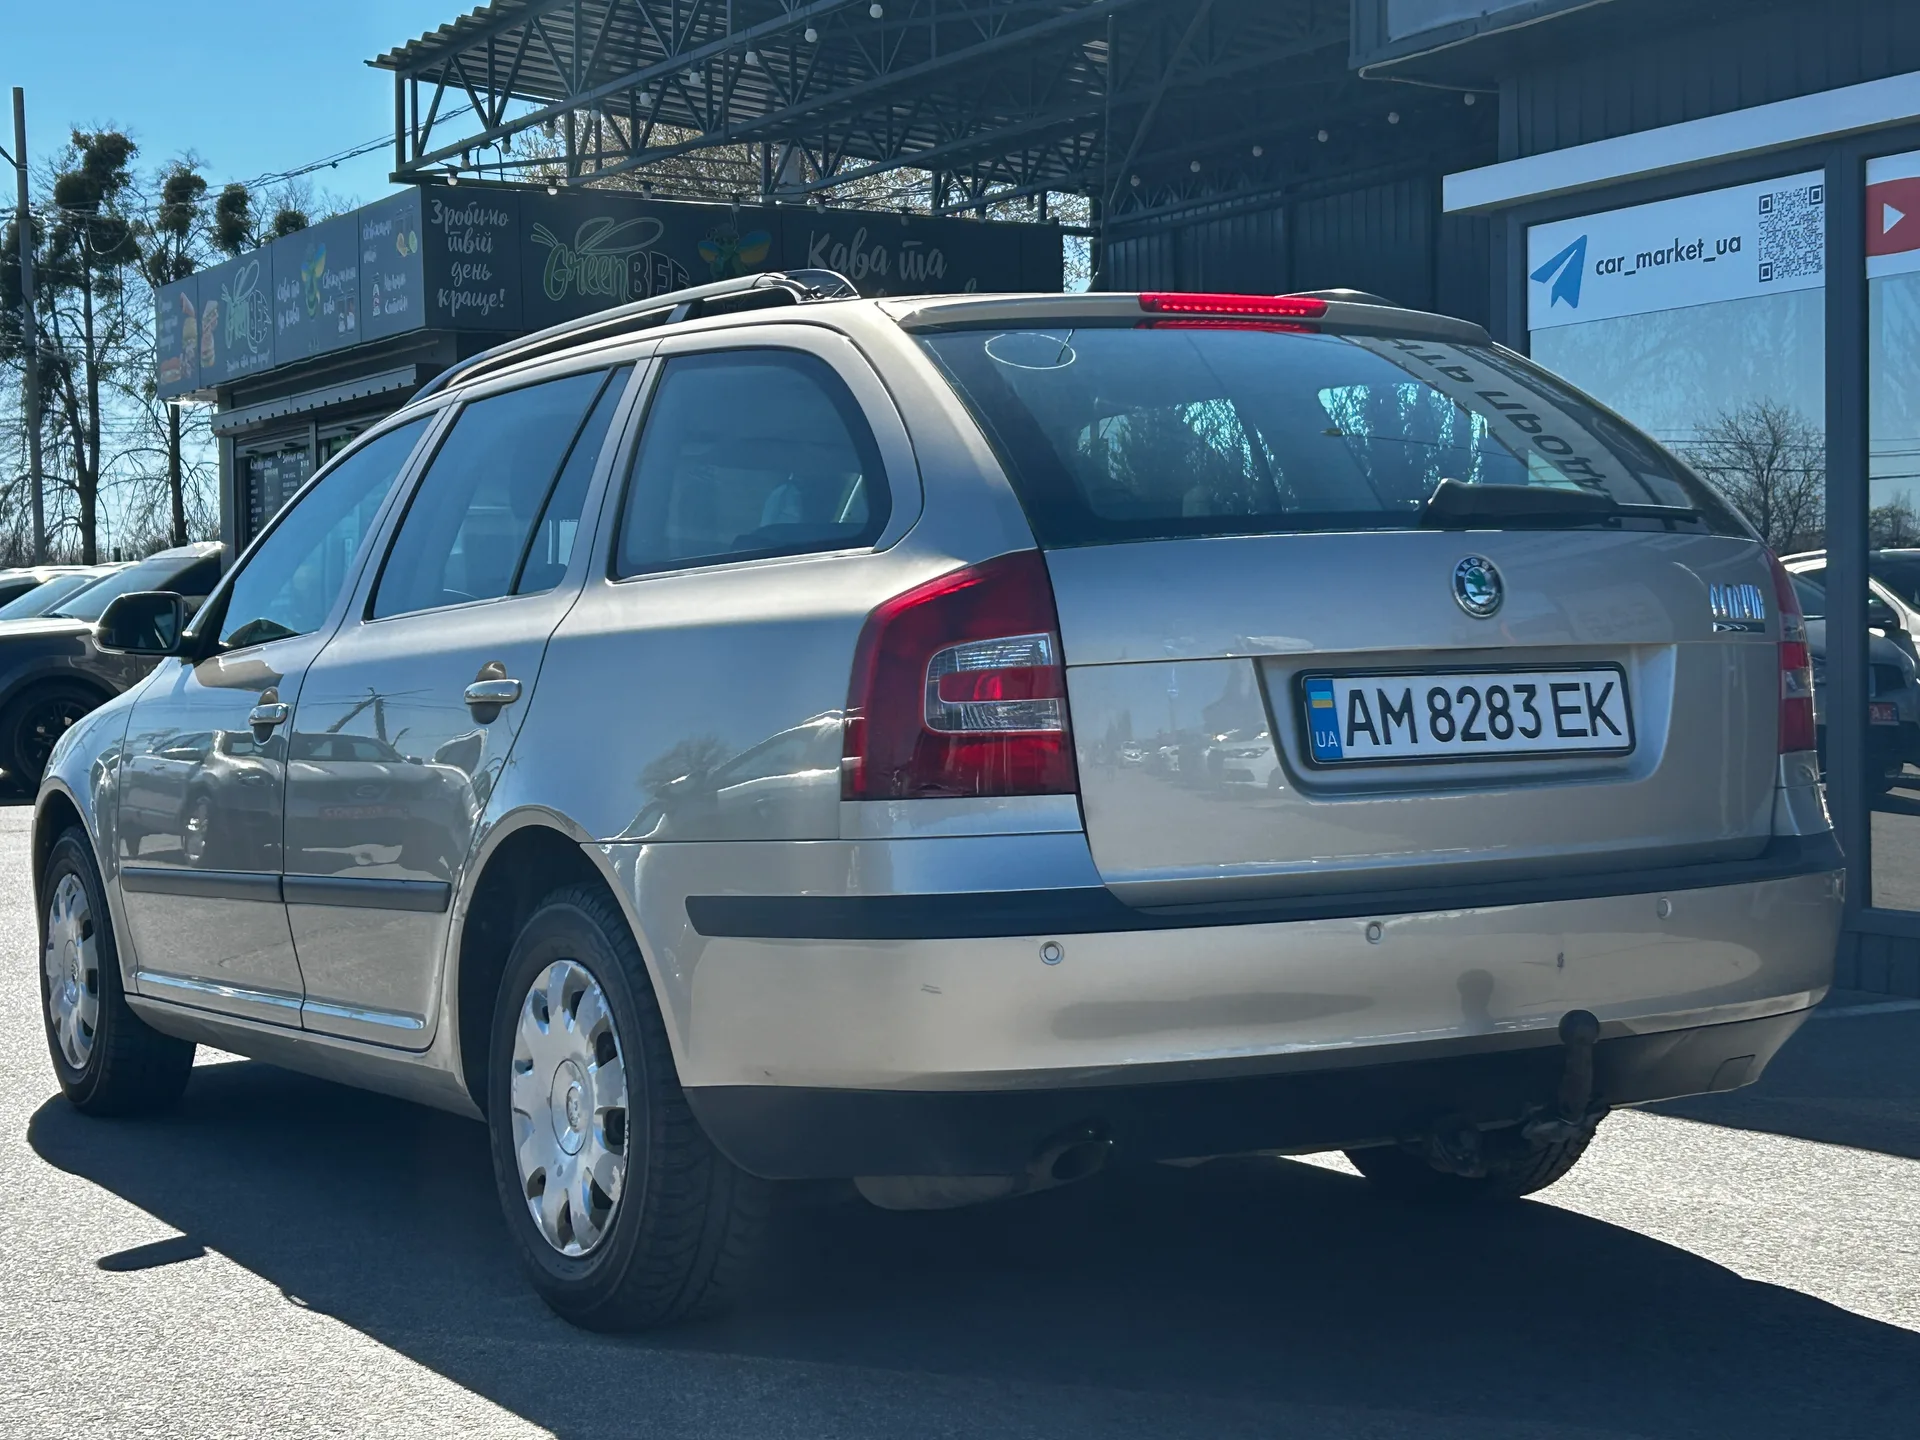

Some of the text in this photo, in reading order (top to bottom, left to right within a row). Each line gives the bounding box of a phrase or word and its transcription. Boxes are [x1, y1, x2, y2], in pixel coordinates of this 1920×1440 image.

[431, 199, 509, 234] Зробимо
[448, 227, 494, 254] твій
[806, 226, 948, 282] Кава та
[1595, 234, 1742, 276] car_market_ua
[451, 259, 493, 287] день
[437, 288, 506, 317] краще!
[1346, 681, 1623, 747] AM 8283 EK
[1315, 730, 1339, 748] UA
